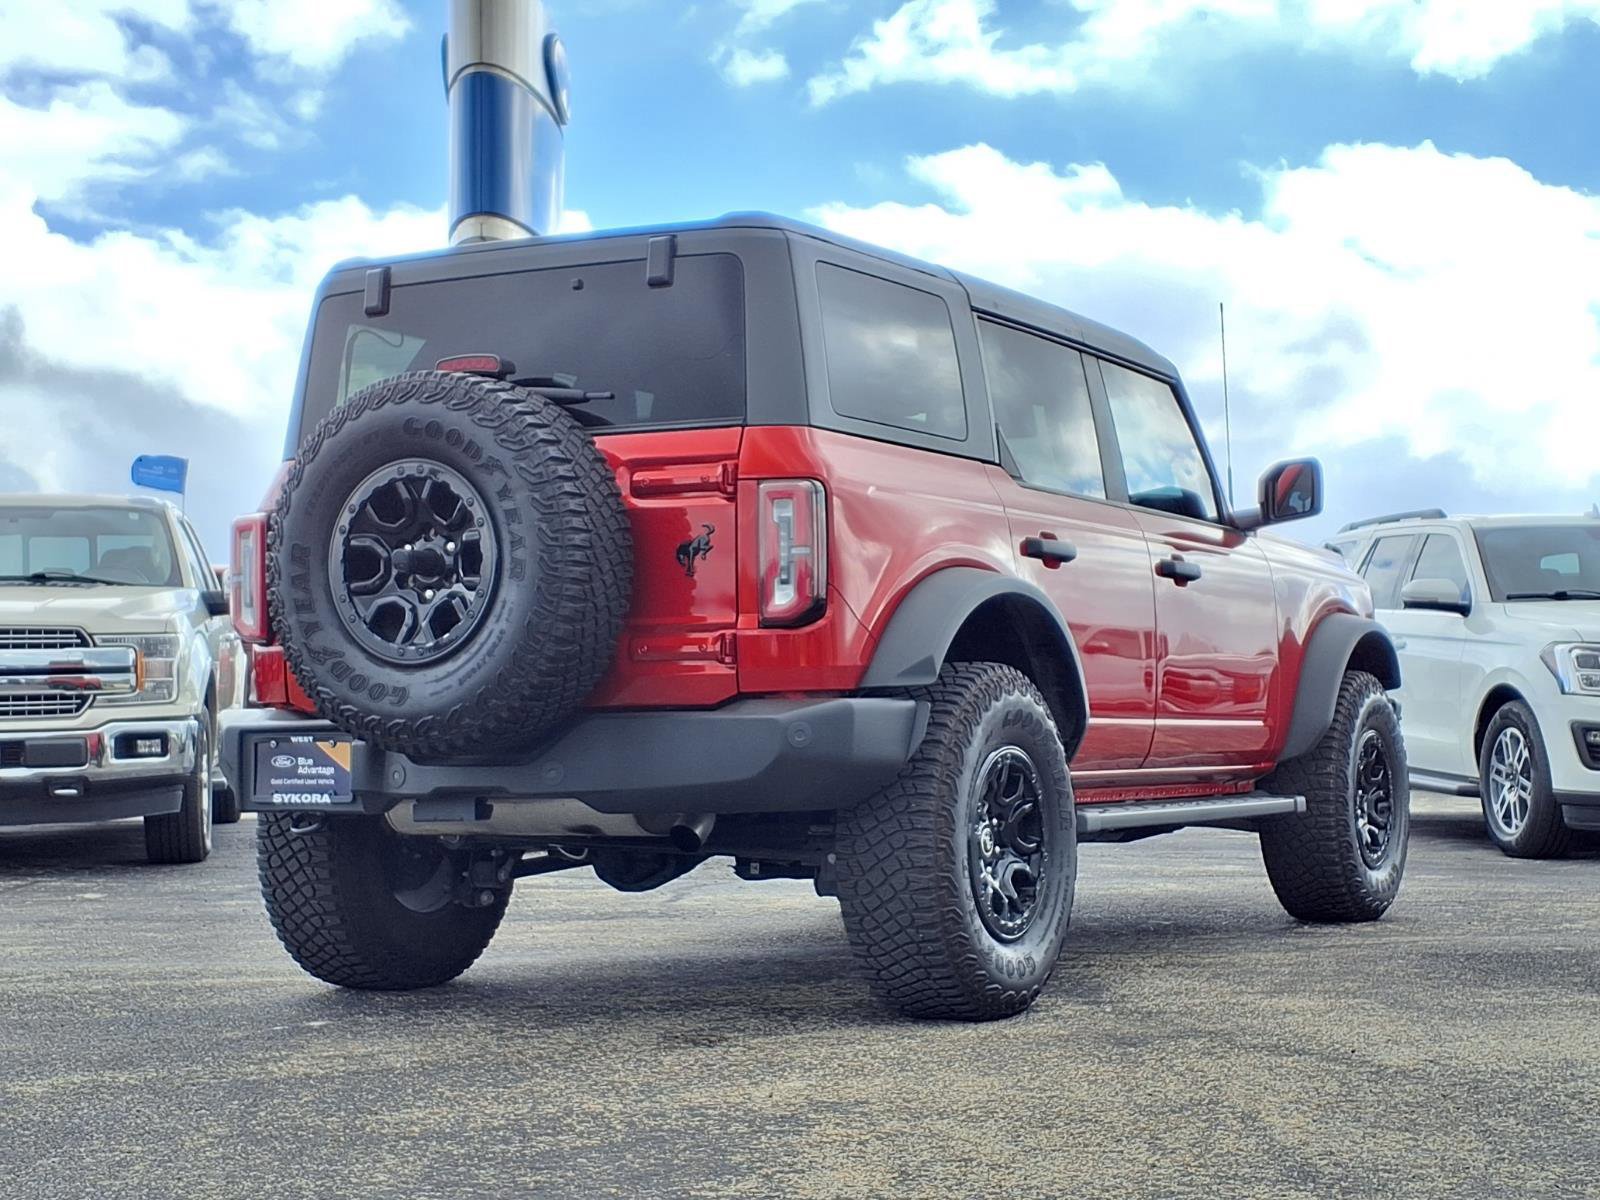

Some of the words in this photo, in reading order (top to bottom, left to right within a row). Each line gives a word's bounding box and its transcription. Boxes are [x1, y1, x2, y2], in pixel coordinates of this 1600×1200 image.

[402, 415, 526, 582] GOODYEAR
[273, 756, 294, 767] Ford
[297, 757, 314, 765] Blue
[297, 766, 335, 775] Advantage
[272, 793, 331, 803] SYKORA
